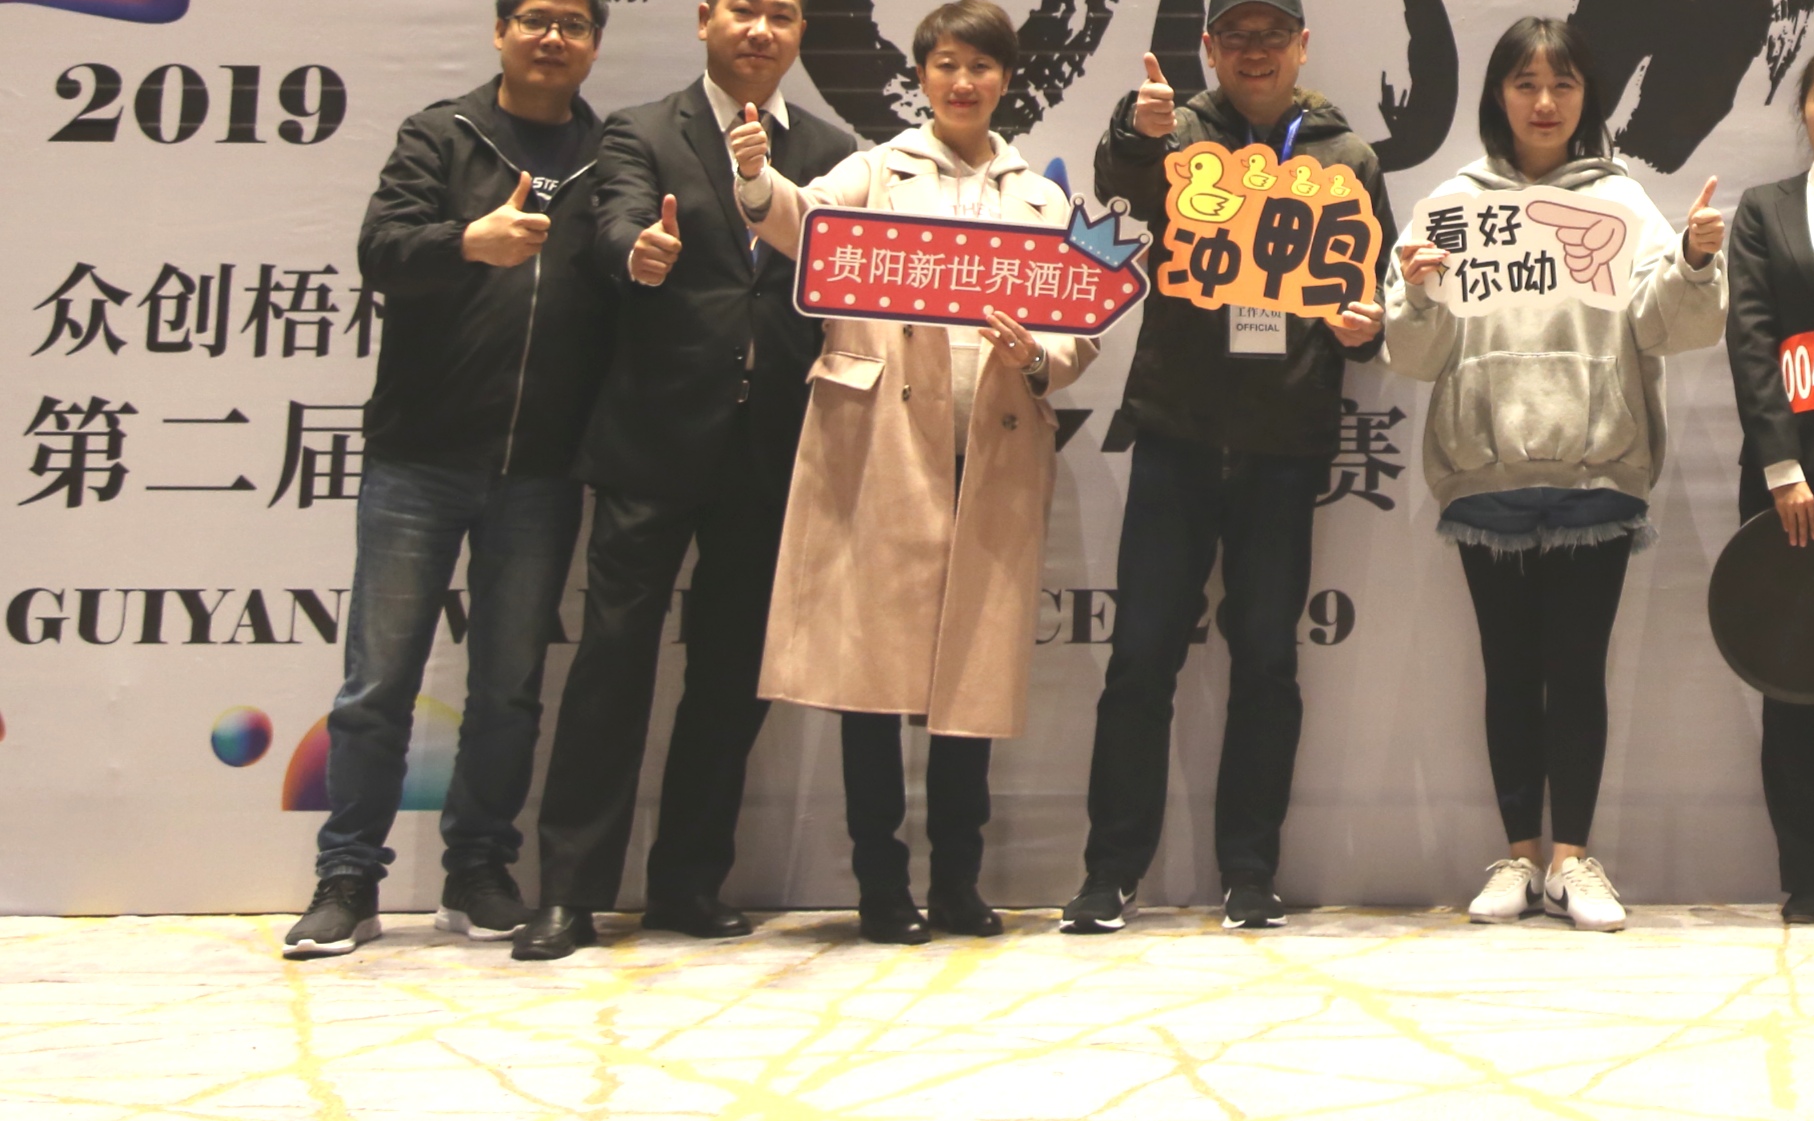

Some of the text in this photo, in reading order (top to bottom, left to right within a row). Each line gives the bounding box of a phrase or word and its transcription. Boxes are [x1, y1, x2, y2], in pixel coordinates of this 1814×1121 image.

[47, 62, 348, 145] 2019
[1426, 205, 1522, 254] 看好
[827, 245, 1101, 305] 贵阳新世界酒店
[1236, 323, 1280, 332] OFFICIAL
[17, 395, 366, 510] 第二届
[5, 587, 351, 646] GUIYAN
